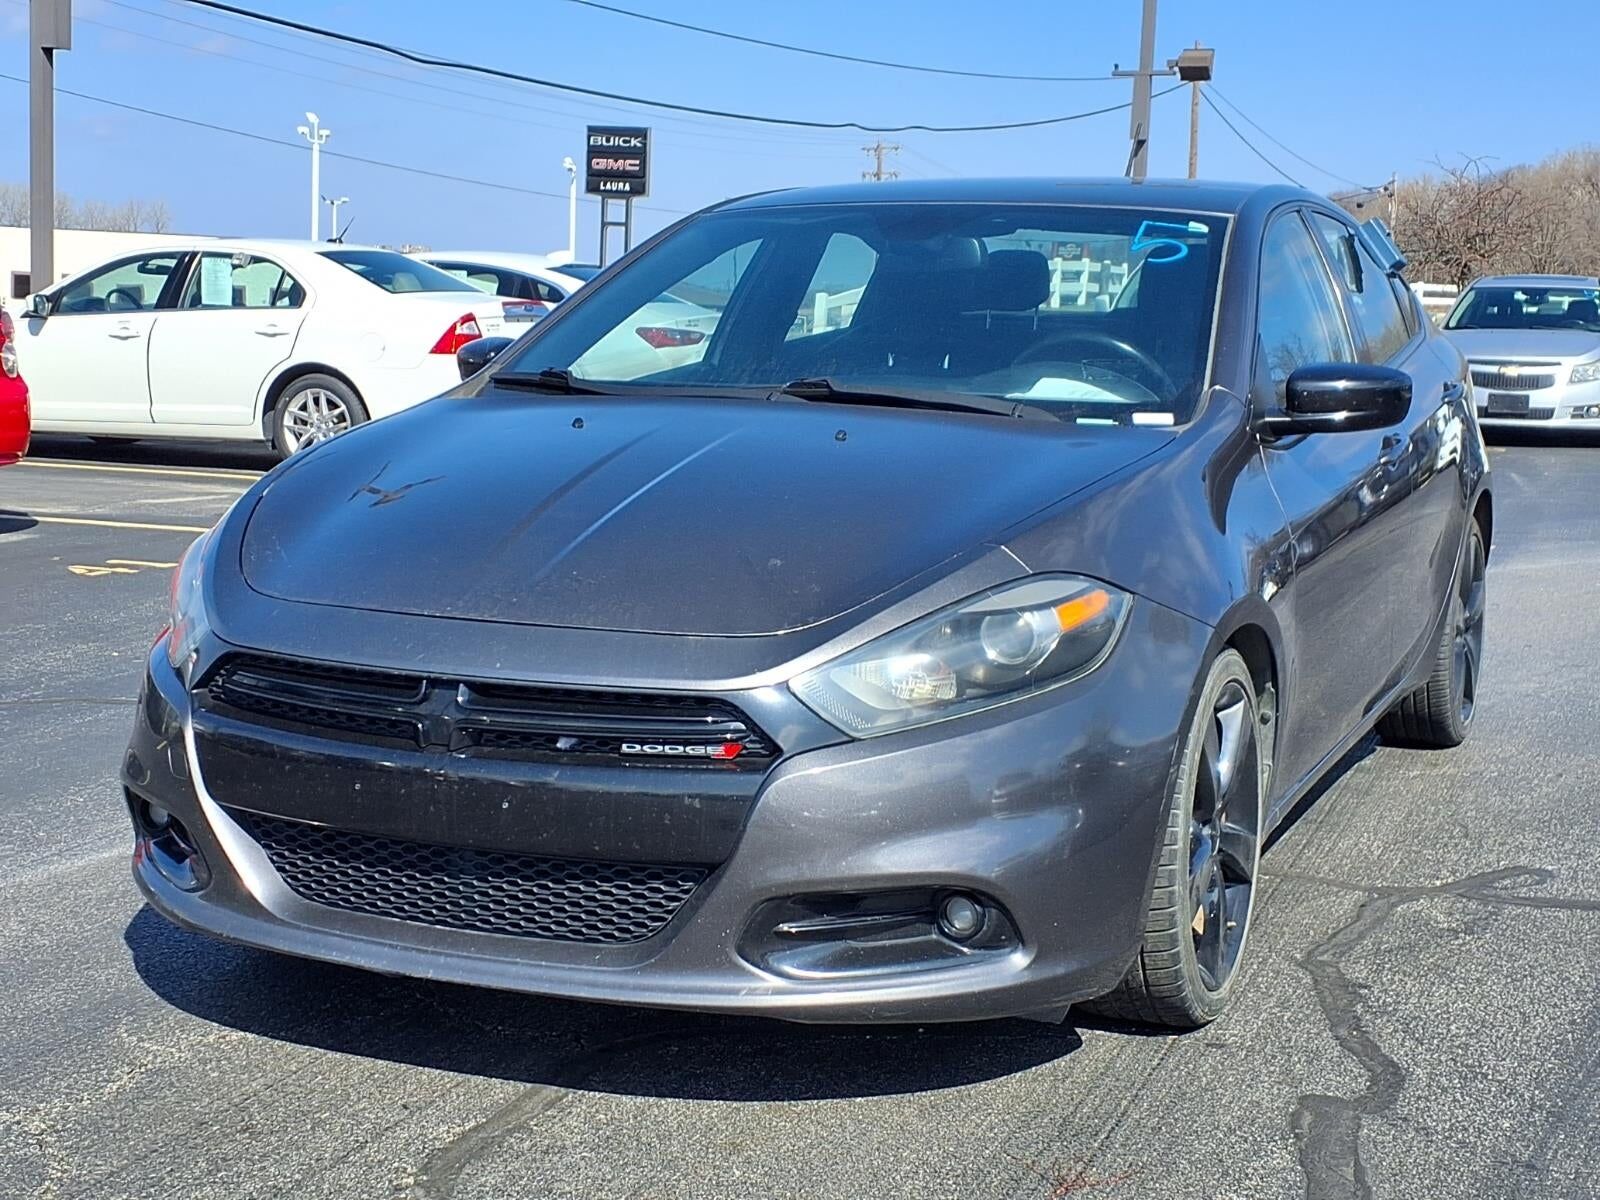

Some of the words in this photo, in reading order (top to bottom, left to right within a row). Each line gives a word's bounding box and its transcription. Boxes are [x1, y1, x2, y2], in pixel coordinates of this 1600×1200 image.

[590, 136, 643, 147] BUICK
[591, 158, 640, 171] GMC
[599, 181, 630, 192] LAURA
[1130, 220, 1199, 263] 5
[621, 743, 726, 756] DODGE
